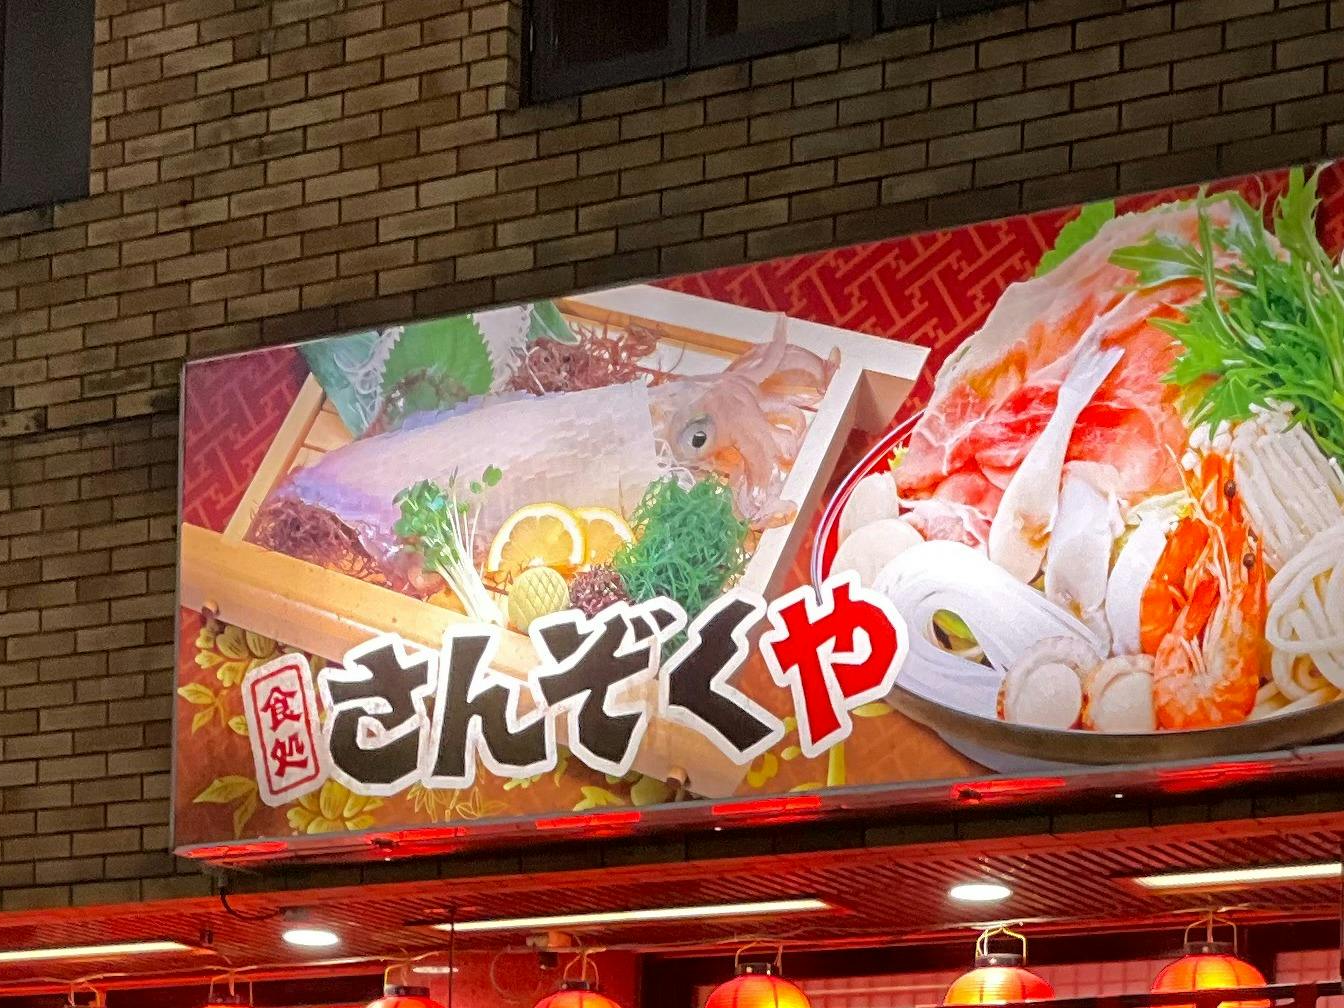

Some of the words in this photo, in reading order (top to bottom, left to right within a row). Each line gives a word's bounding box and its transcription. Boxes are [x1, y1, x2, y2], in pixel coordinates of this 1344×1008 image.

[261, 684, 309, 778] 食処
[328, 582, 900, 786] さんぞくや
